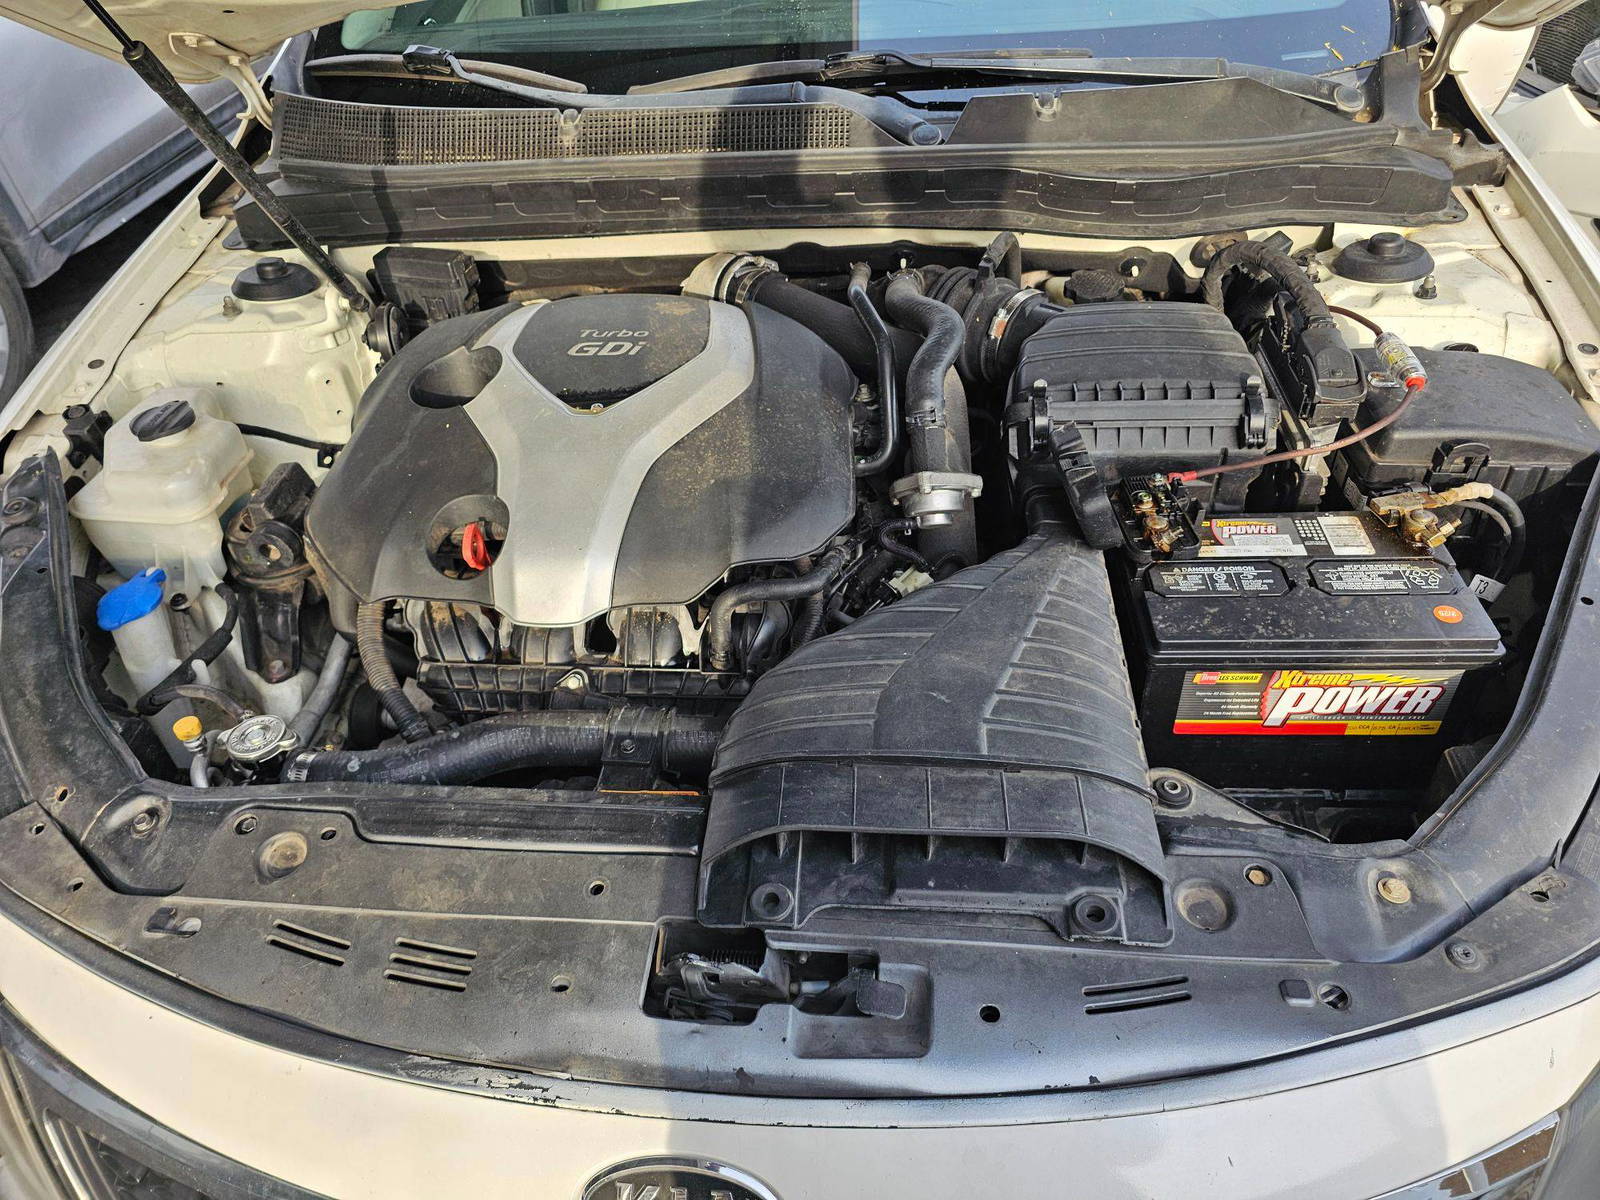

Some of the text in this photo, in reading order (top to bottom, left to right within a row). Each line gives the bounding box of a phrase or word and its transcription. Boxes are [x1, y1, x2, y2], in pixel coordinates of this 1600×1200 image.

[580, 328, 650, 338] Turbo
[567, 341, 647, 356] GDi
[1222, 525, 1277, 538] POWER
[1475, 580, 1489, 594] T3
[1271, 669, 1354, 690] Xtreme
[1262, 685, 1447, 728] POWER
